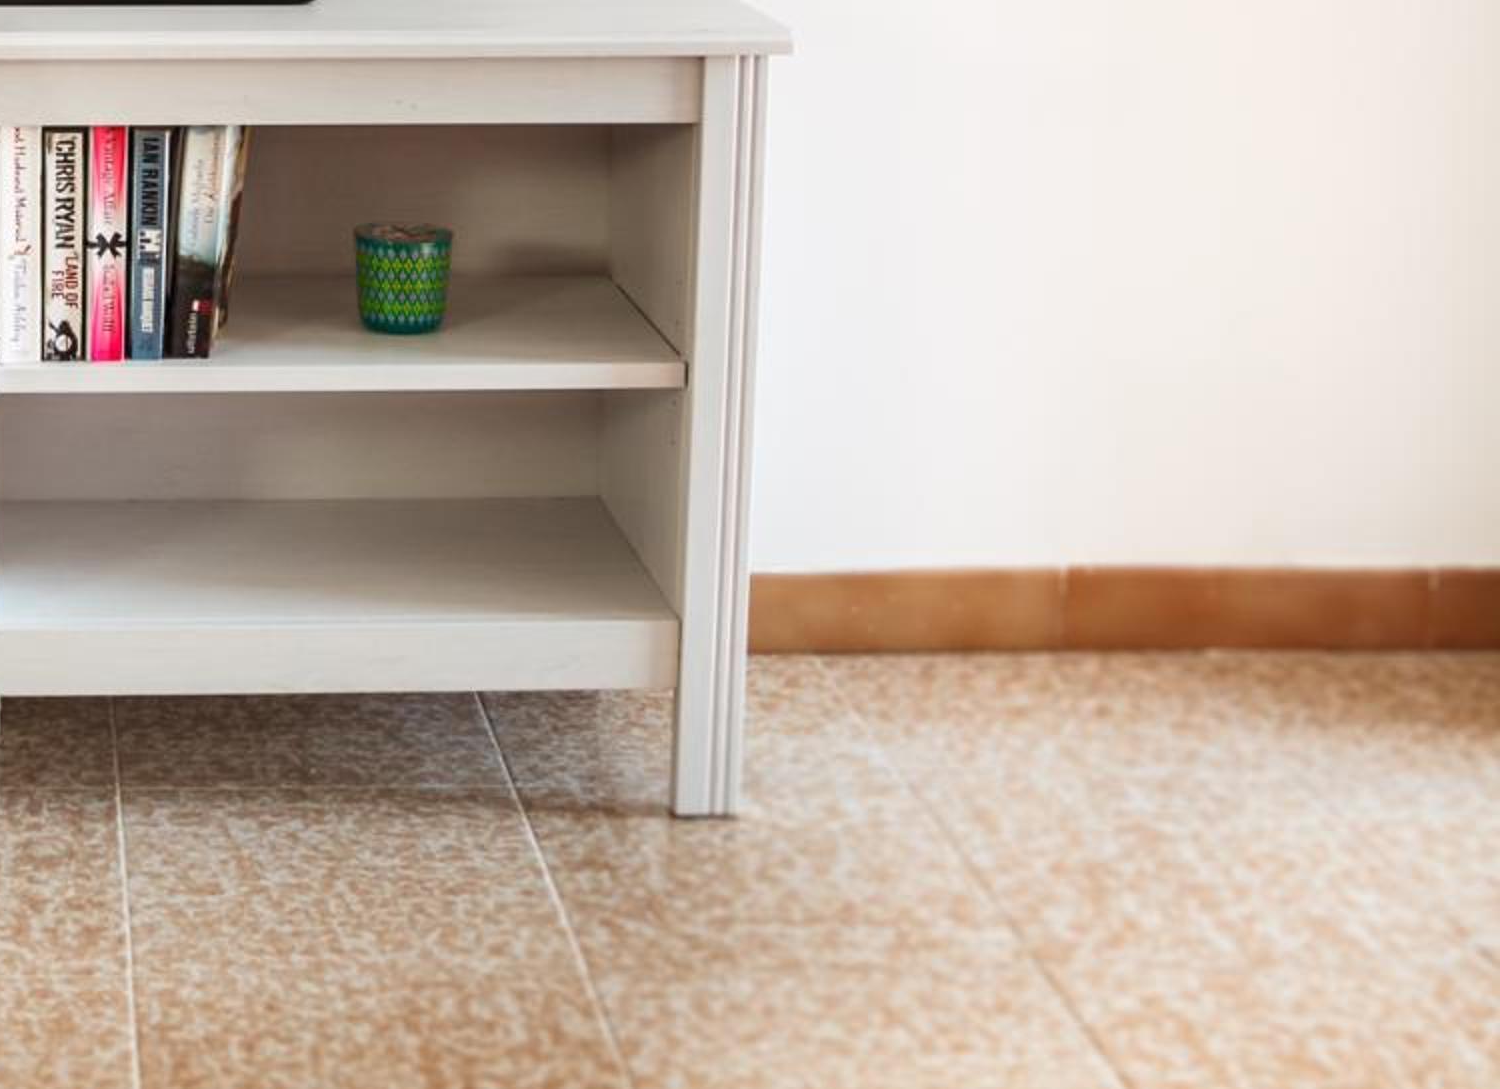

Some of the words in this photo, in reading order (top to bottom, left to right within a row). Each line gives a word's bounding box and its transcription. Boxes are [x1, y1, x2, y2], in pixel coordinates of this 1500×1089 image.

[55, 139, 76, 193] CHRIS
[142, 137, 160, 163] IAN
[141, 169, 159, 226] RANKIN
[55, 197, 75, 249] RYAN
[52, 271, 65, 299] FIRE
[65, 255, 79, 289] LAND
[65, 292, 79, 309] OF
